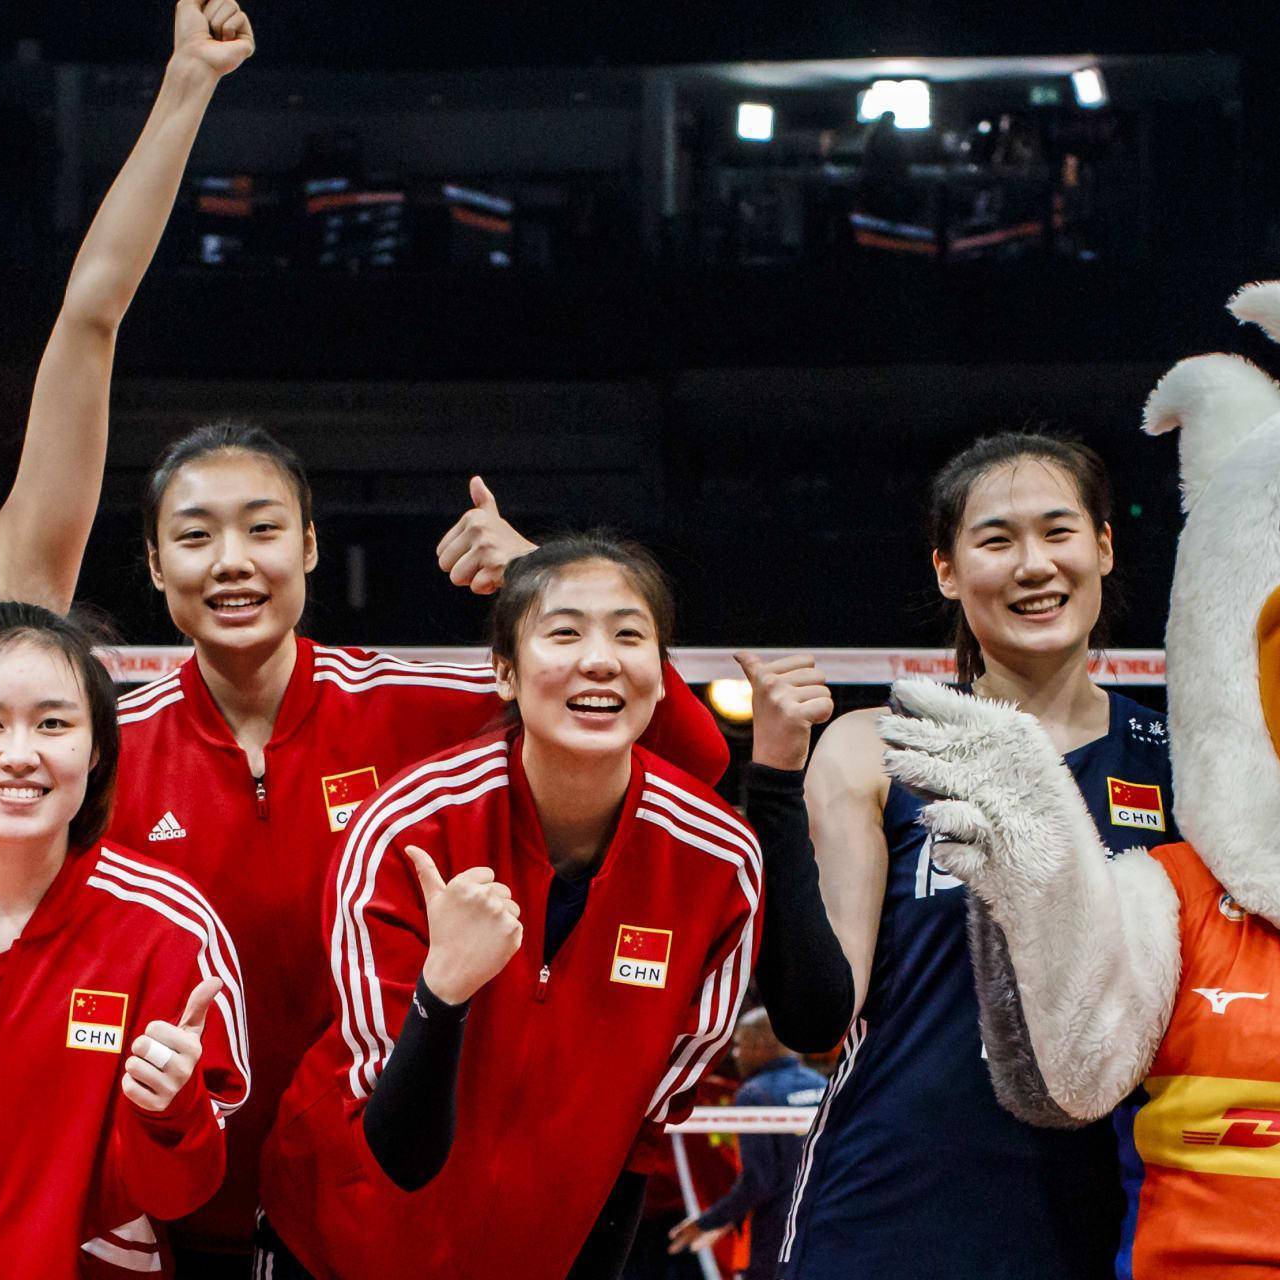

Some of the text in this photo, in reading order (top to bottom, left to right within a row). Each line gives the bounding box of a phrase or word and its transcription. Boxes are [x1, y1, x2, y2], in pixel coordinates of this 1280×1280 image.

[1118, 810, 1158, 826] CHN
[148, 828, 186, 841] adidas
[618, 963, 662, 983] CHN
[74, 1029, 117, 1047] CHN
